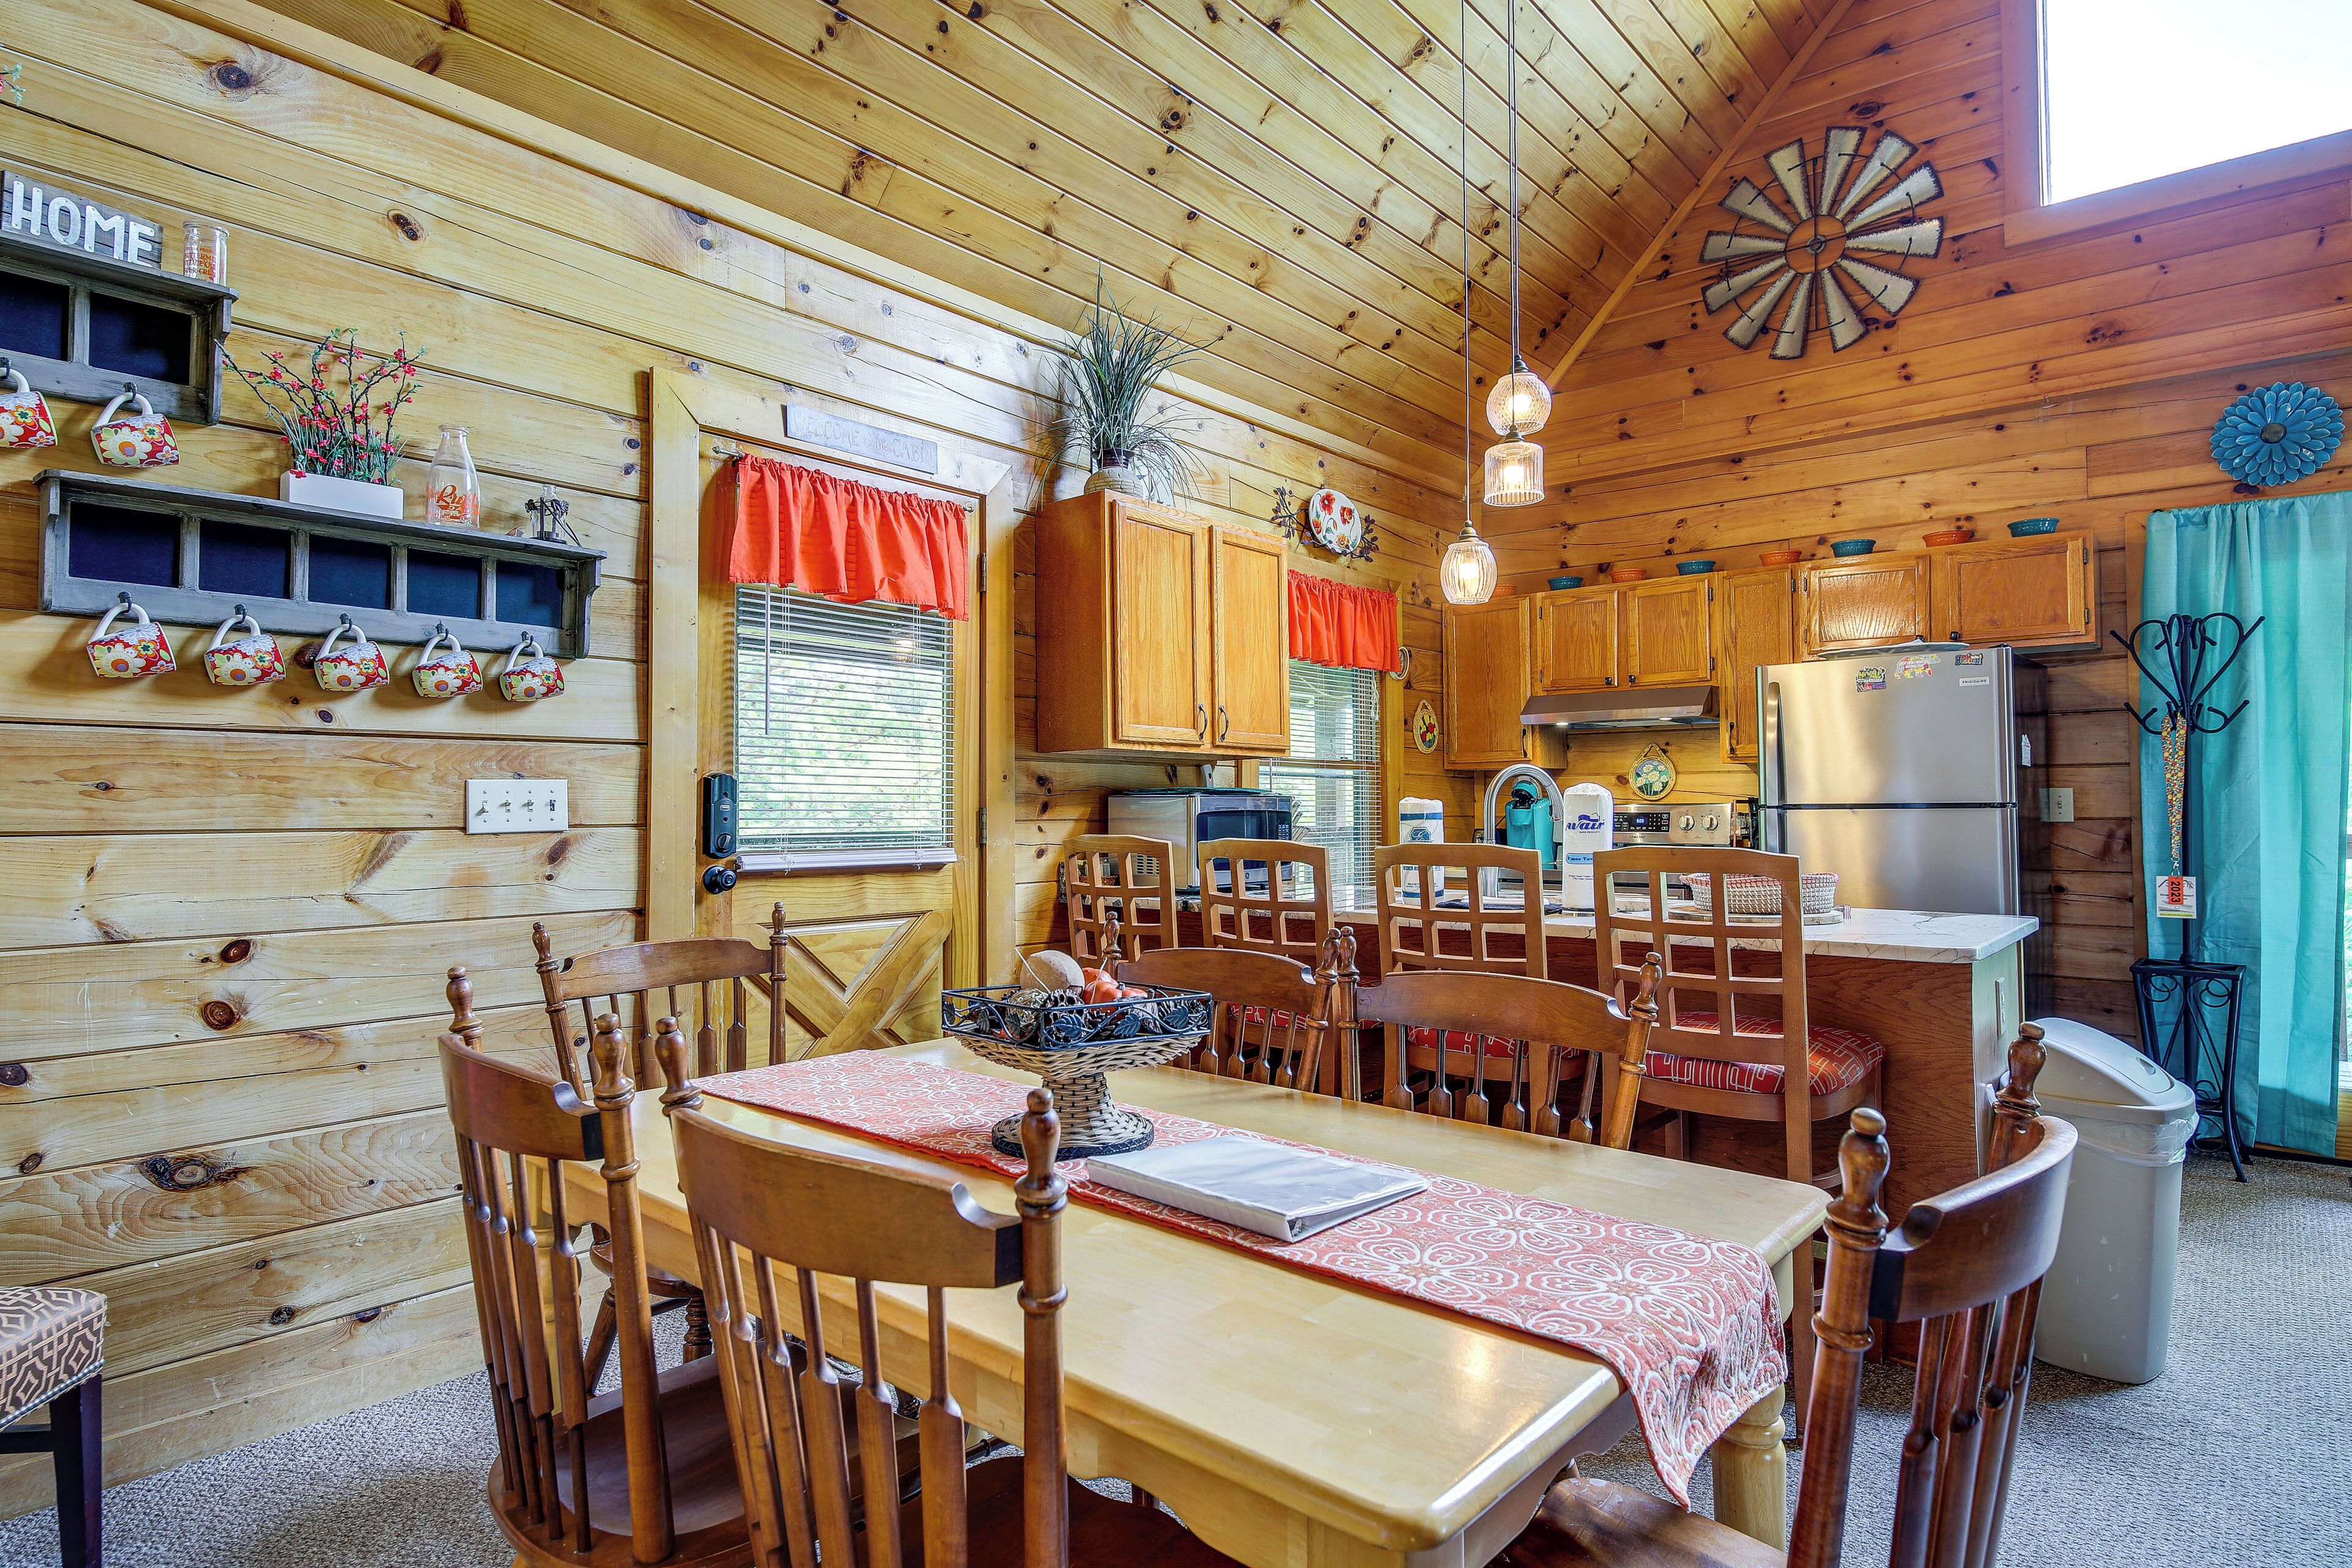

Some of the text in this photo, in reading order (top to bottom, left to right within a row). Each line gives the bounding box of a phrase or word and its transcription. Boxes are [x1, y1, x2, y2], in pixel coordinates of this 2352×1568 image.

[11, 180, 155, 268] HOME
[792, 409, 935, 463] WELCOME to the CABIN
[2171, 881, 2180, 902] 2023
